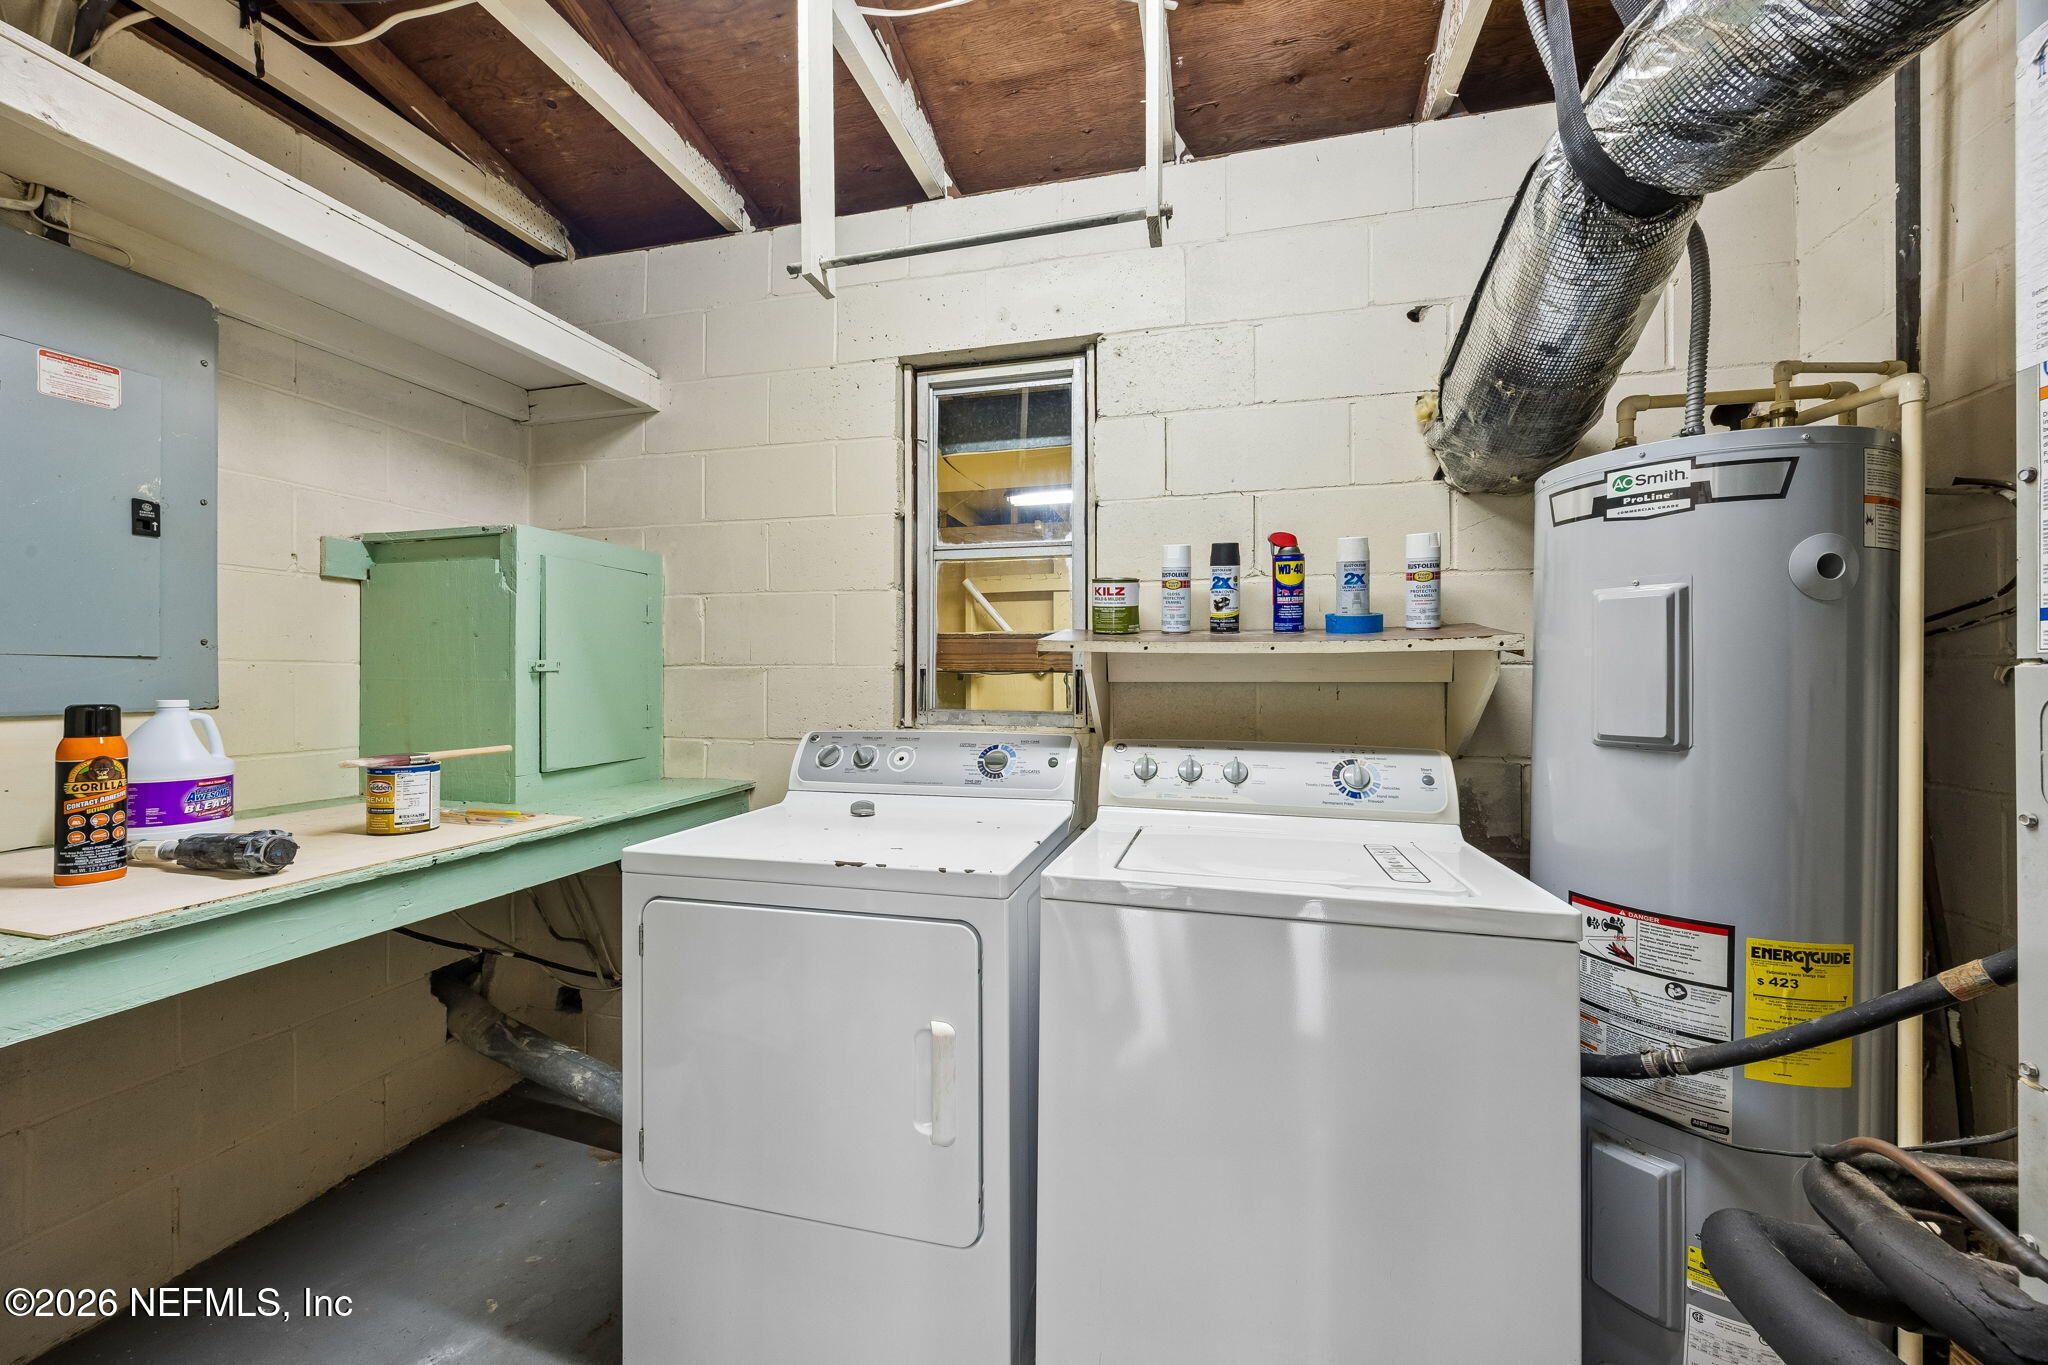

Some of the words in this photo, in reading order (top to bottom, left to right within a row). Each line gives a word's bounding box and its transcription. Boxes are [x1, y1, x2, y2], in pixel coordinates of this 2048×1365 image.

[1636, 469, 1686, 486] Smith
[1623, 493, 1671, 505] ProLine
[1617, 506, 1656, 515] COMMERCIAL
[1278, 564, 1304, 574] WD-40
[1212, 576, 1232, 589] 2X
[1344, 572, 1366, 585] 2X
[1094, 586, 1126, 596] KILZ
[72, 781, 122, 792] GORILLA
[67, 798, 98, 810] CONTACT
[184, 796, 232, 814] BLEACH
[1628, 912, 1660, 924] DANGER
[1751, 946, 1850, 965] ENERGYGUIDE
[1769, 977, 1799, 989] 423
